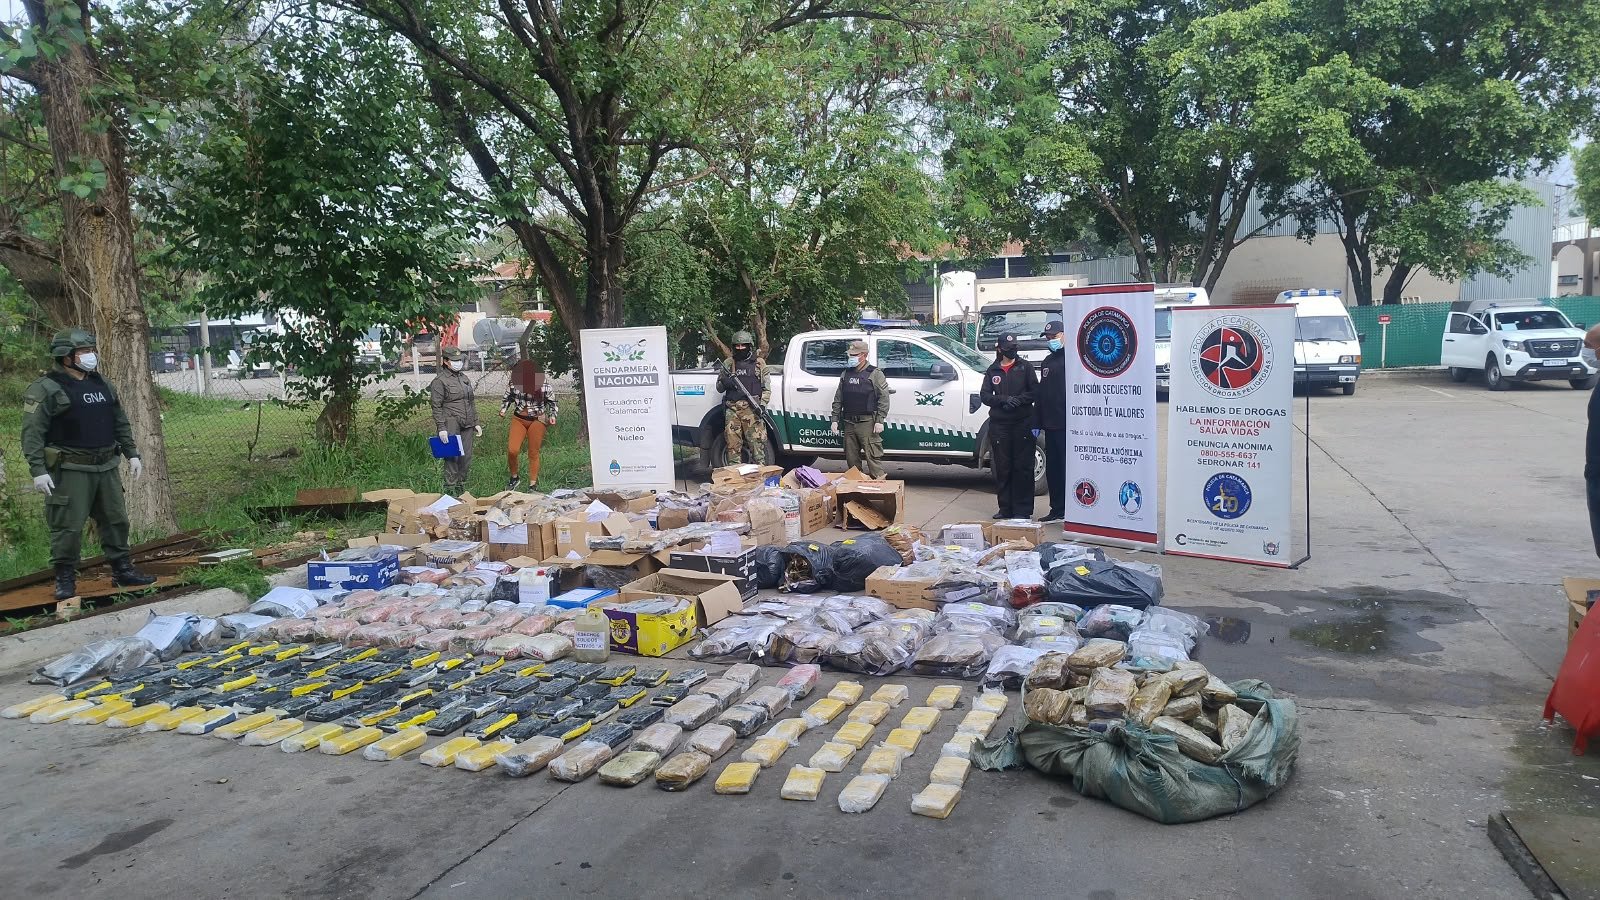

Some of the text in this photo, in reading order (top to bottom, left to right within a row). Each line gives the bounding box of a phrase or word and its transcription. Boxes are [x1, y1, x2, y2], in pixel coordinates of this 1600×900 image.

[1193, 317, 1271, 351] POLICIA DE CATAMARCA
[593, 363, 658, 374] GENDARMERÍA
[597, 375, 656, 386] NACIONAL
[1212, 388, 1242, 397] DROGAS
[1242, 359, 1272, 395] PELIGROSAS
[1073, 382, 1142, 395] DIVISIÓN SECUESTRO
[83, 391, 107, 404] GNA
[643, 397, 653, 405] 67
[1104, 396, 1109, 405] Y
[1071, 405, 1145, 418] CUSTODIA DE VALORES
[1176, 405, 1287, 417] HABLEMOS DE DROGAS
[1190, 418, 1271, 429] LA INFORMACIÓN
[798, 428, 845, 438] GENDARME
[1199, 426, 1260, 437] SALVA VIDAS
[799, 437, 841, 446] NACIONAL
[1187, 439, 1273, 451] DENUNCIA ANÓNIMA
[1074, 445, 1143, 458] DENUNCIA ANÓNIMA
[1200, 449, 1258, 460] 0800-555-6637
[1080, 453, 1137, 466] 0800-555-6637
[1197, 458, 1261, 469] SEDRONAR 141
